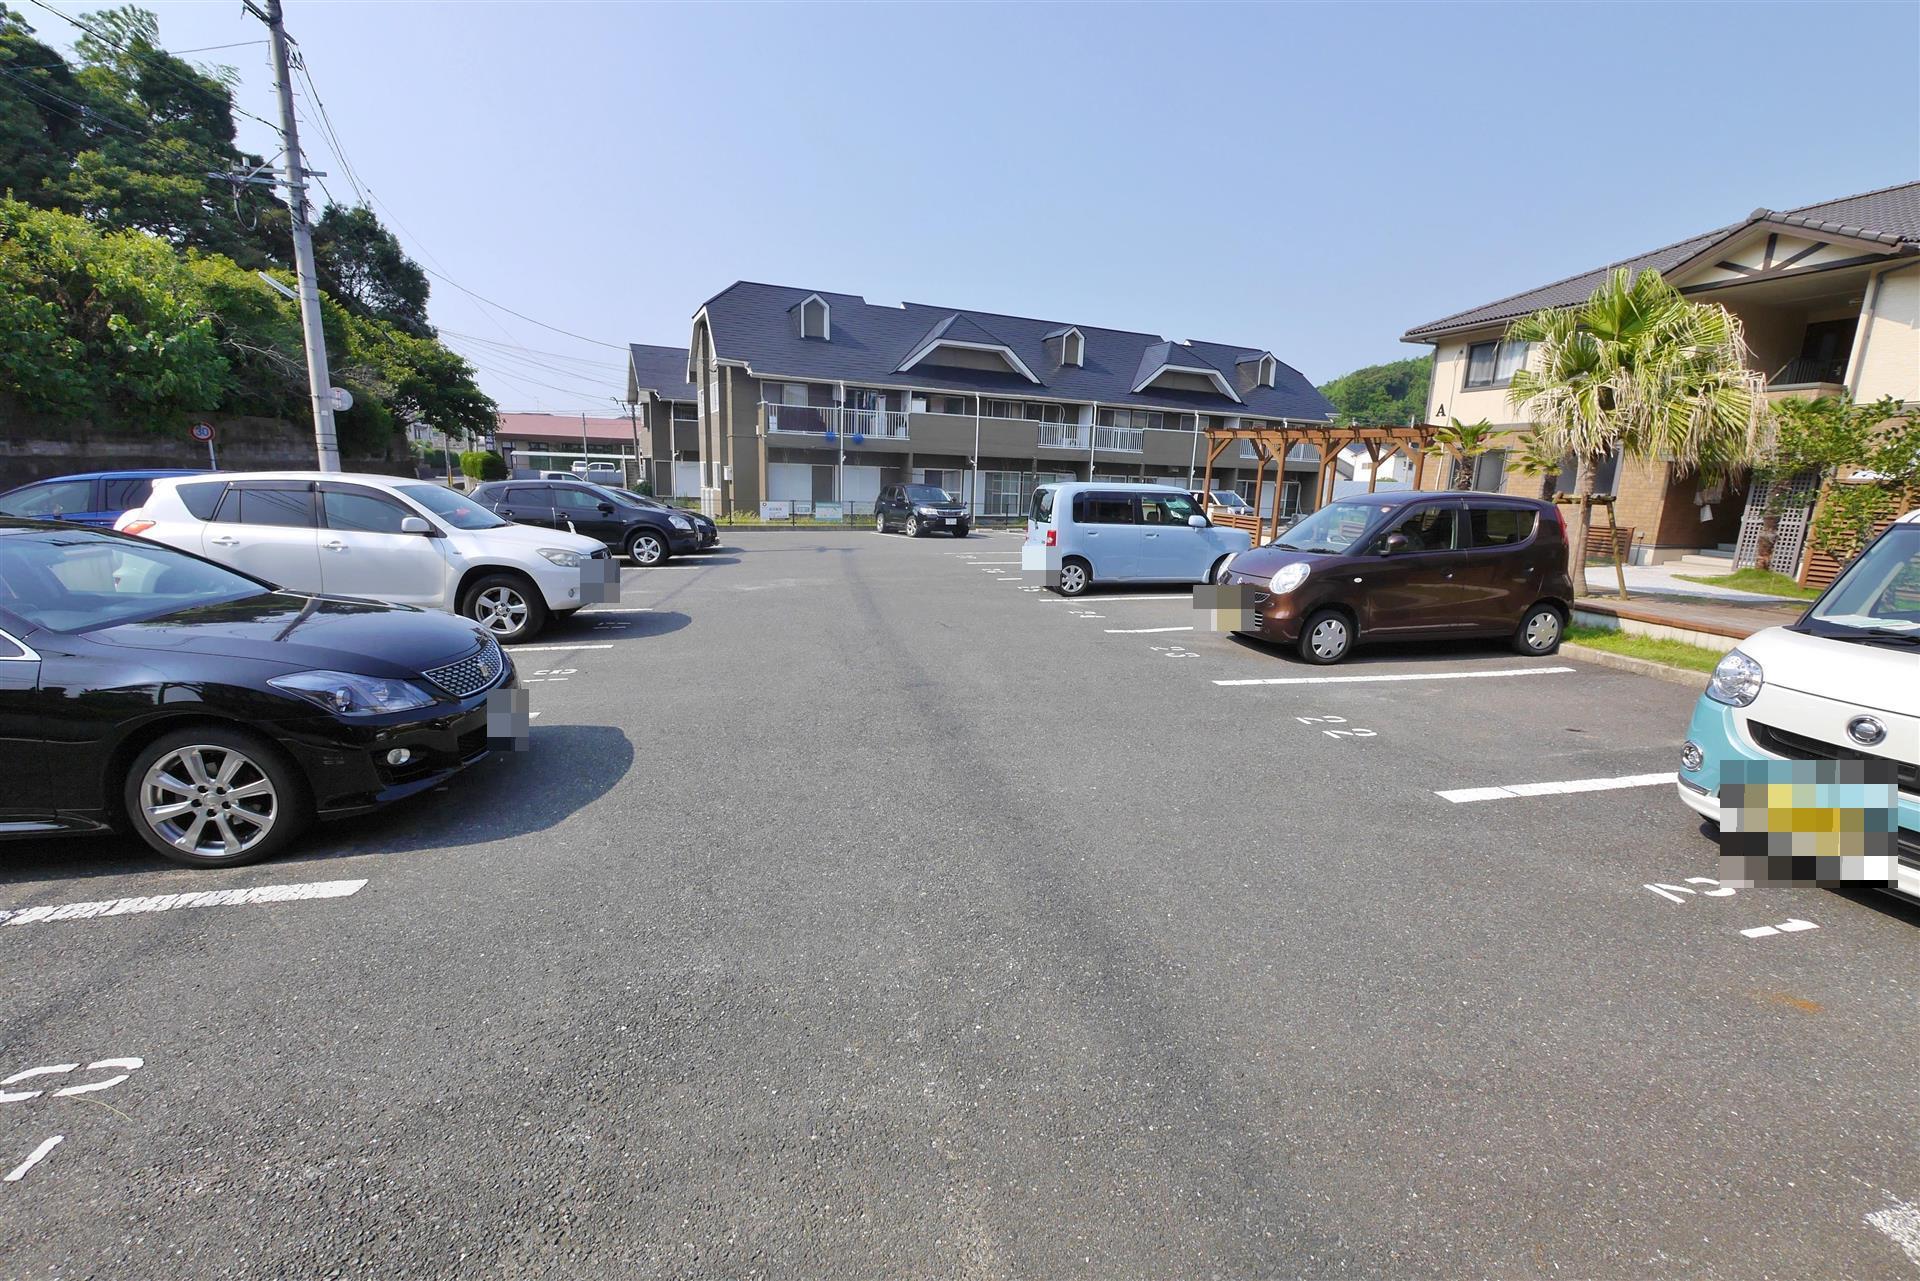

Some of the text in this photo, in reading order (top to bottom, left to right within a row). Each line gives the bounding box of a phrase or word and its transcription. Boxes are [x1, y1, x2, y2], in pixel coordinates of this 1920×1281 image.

[1436, 403, 1446, 417] A
[1295, 715, 1378, 739] 22
[1643, 876, 1821, 938] 21
